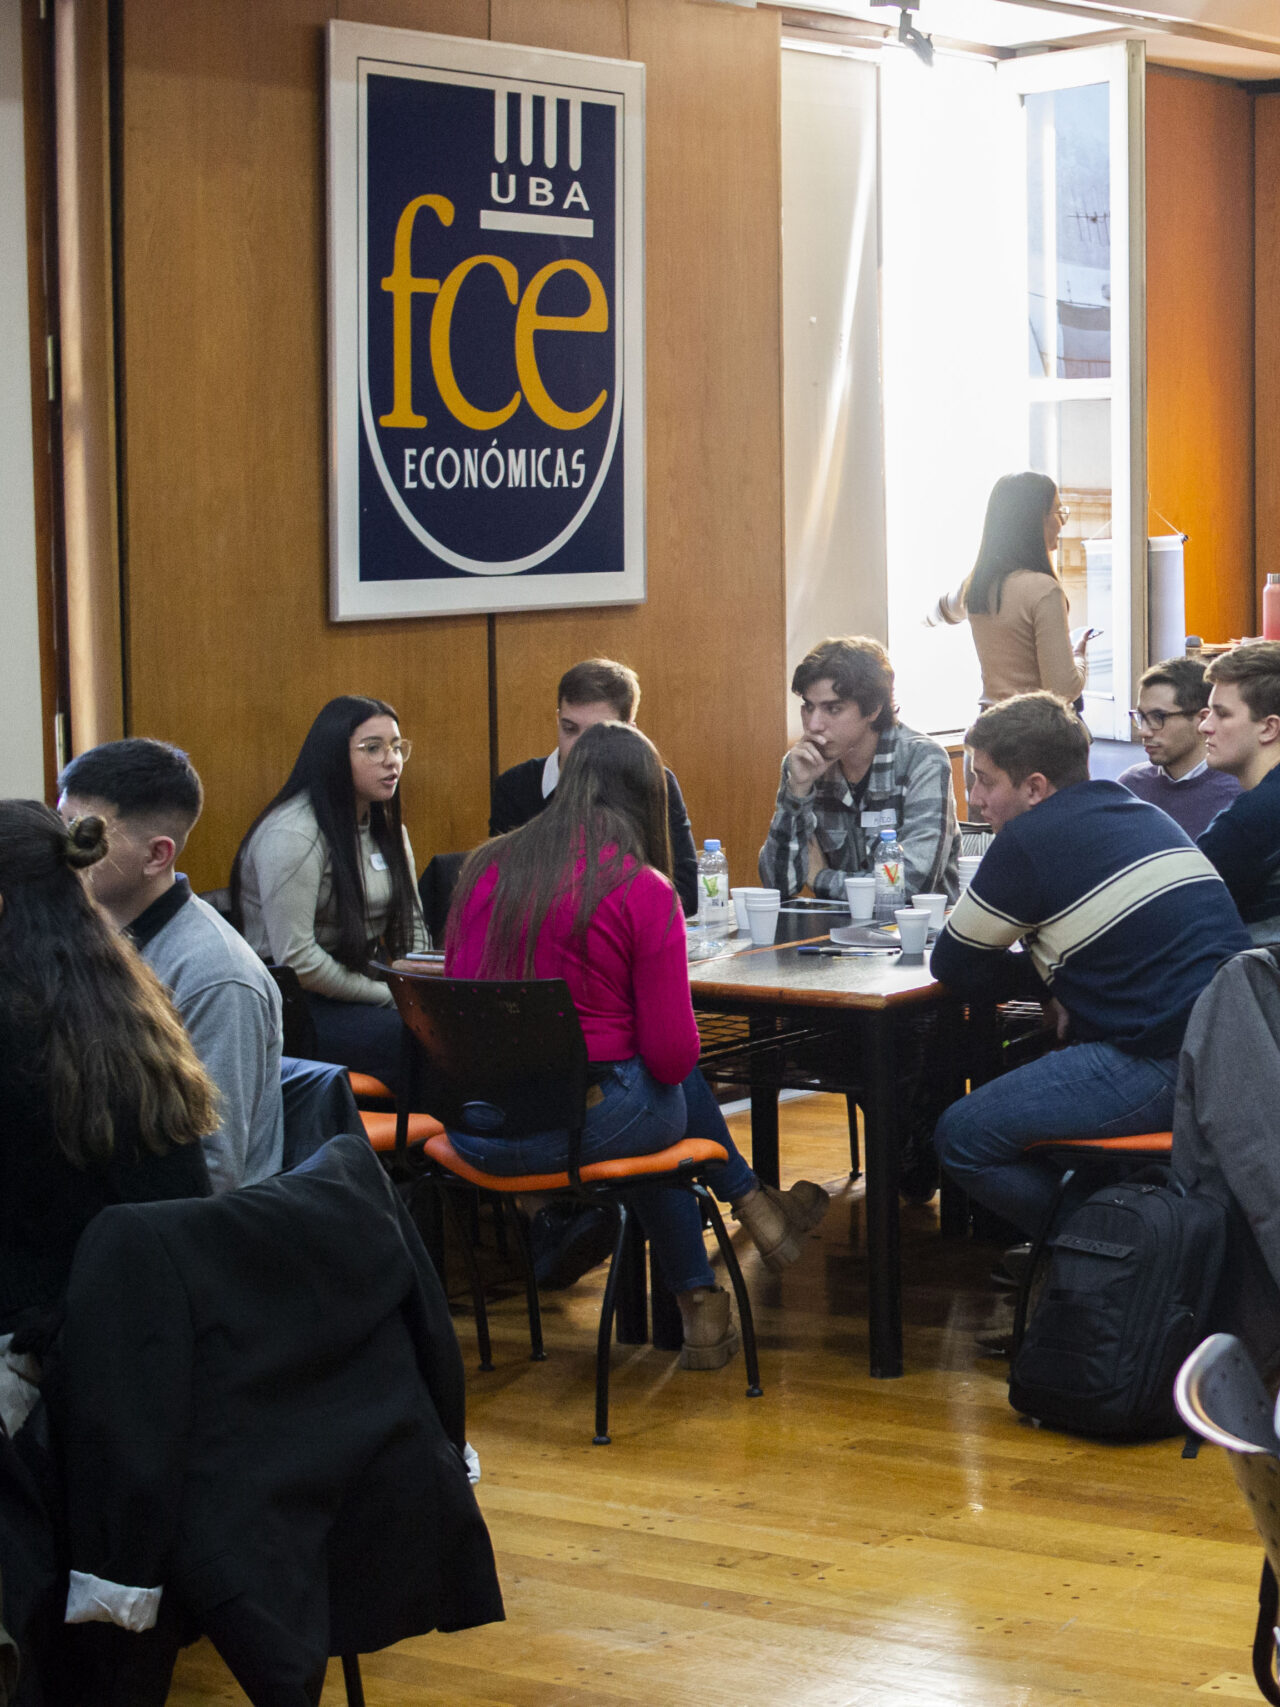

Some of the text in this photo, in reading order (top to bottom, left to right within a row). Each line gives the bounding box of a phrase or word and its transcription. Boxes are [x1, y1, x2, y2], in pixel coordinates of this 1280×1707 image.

[490, 171, 591, 212] UBA
[378, 193, 609, 431] fce
[403, 439, 587, 490] ECONÓMICAS
